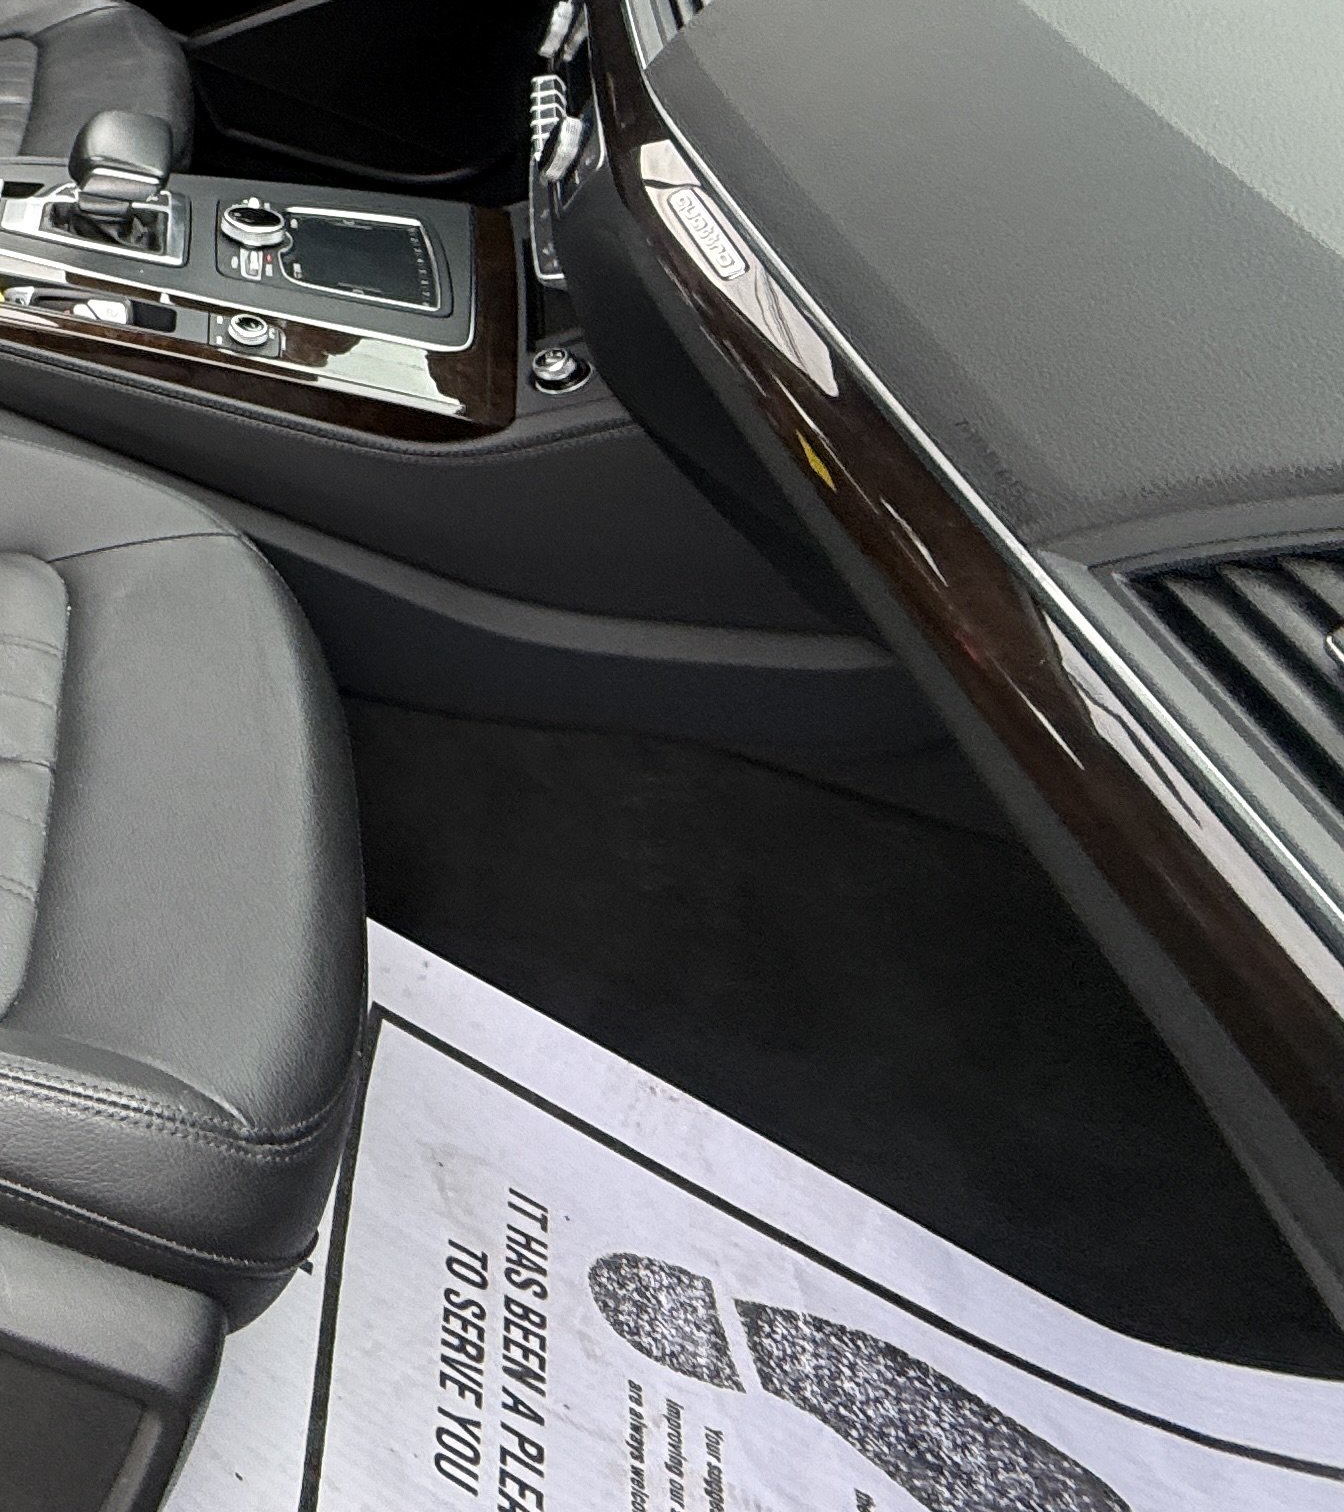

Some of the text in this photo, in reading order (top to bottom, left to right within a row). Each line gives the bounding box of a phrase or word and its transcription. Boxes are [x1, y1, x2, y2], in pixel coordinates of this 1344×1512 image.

[676, 196, 735, 268] quattro
[507, 1187, 549, 1234] IT
[504, 1223, 549, 1301] HAS
[434, 1238, 489, 1497] TO SERVE YOU
[501, 1294, 548, 1398] BEEN
[501, 1385, 546, 1427] A
[625, 1379, 650, 1512] are always welco
[703, 1425, 725, 1512] Your sugge
[669, 1478, 685, 1509] our
